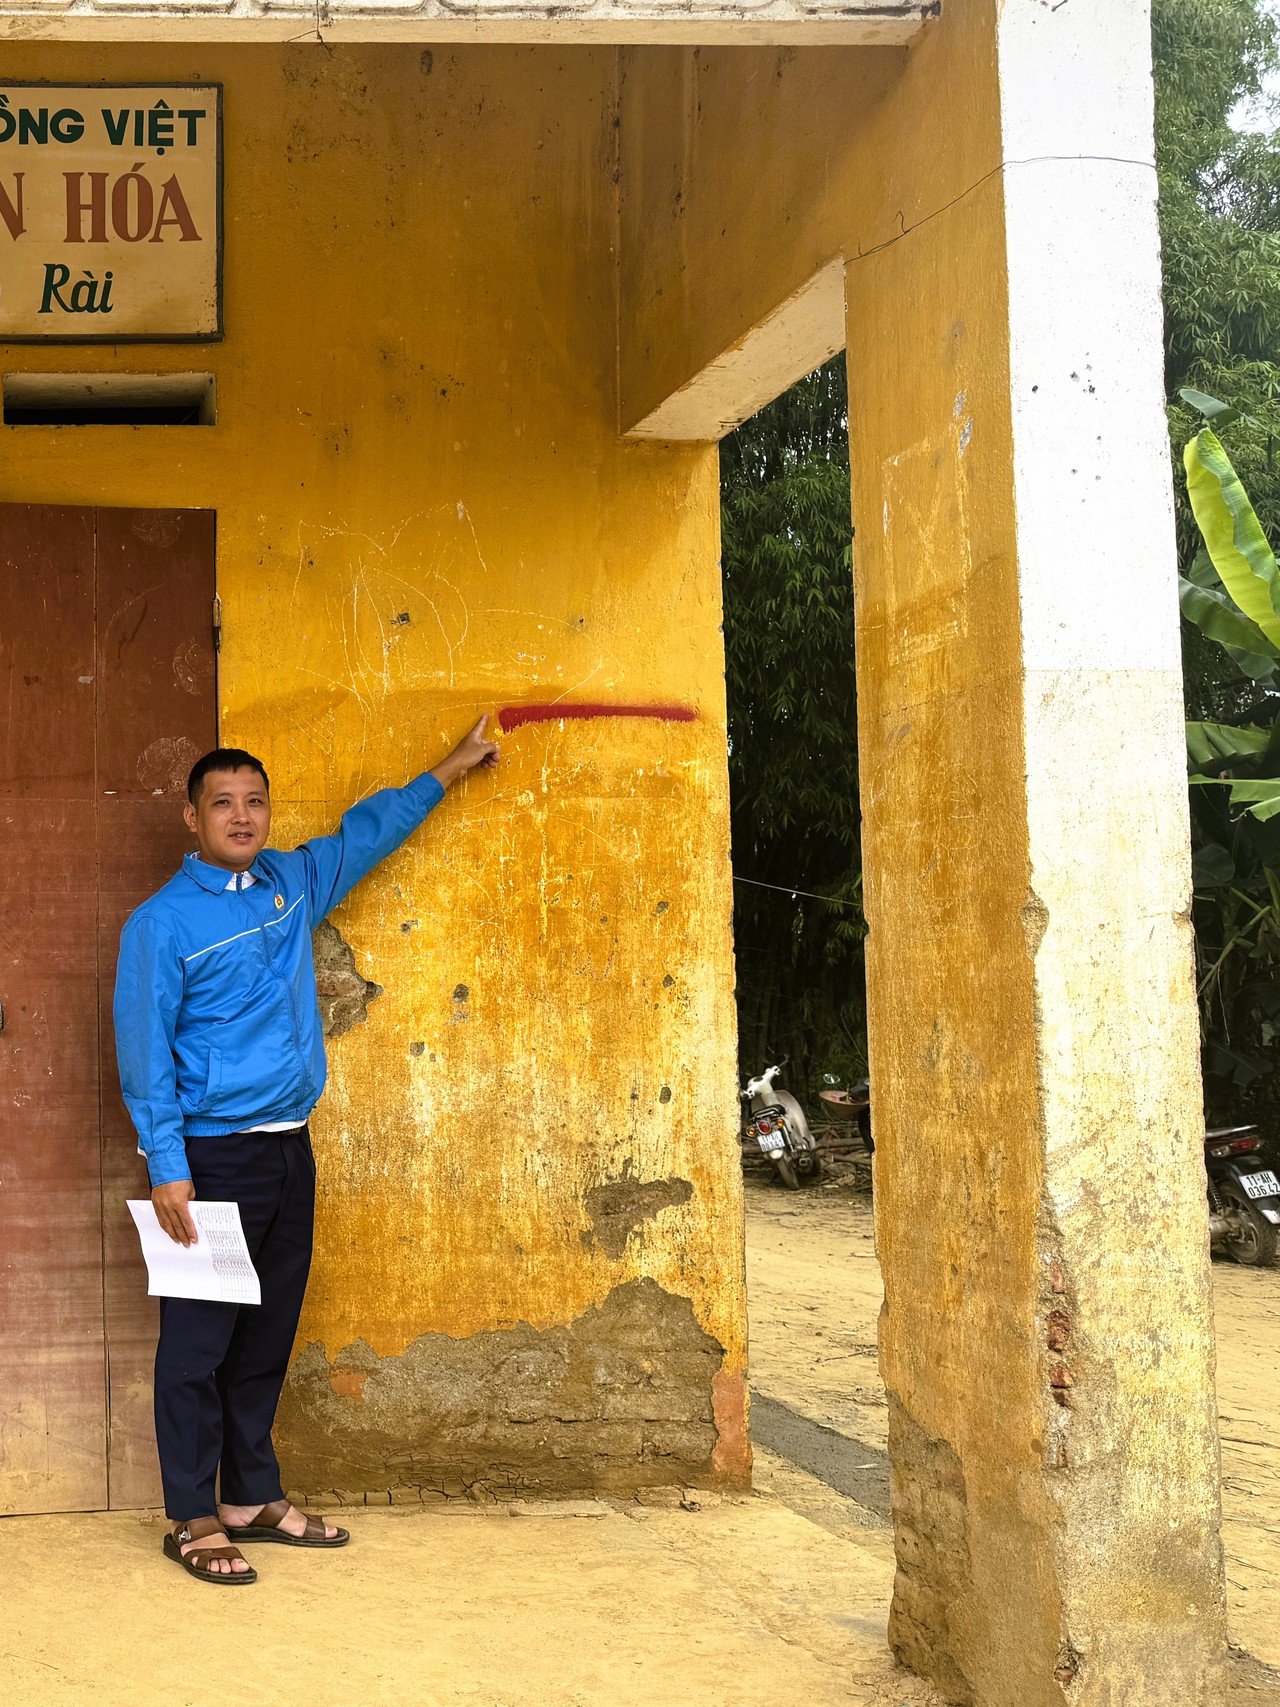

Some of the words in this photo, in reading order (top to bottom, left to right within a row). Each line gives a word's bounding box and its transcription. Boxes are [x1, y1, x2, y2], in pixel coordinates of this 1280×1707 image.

[100, 98, 207, 156] VIỆT
[62, 161, 203, 244] HÓA
[37, 263, 114, 314] Rài
